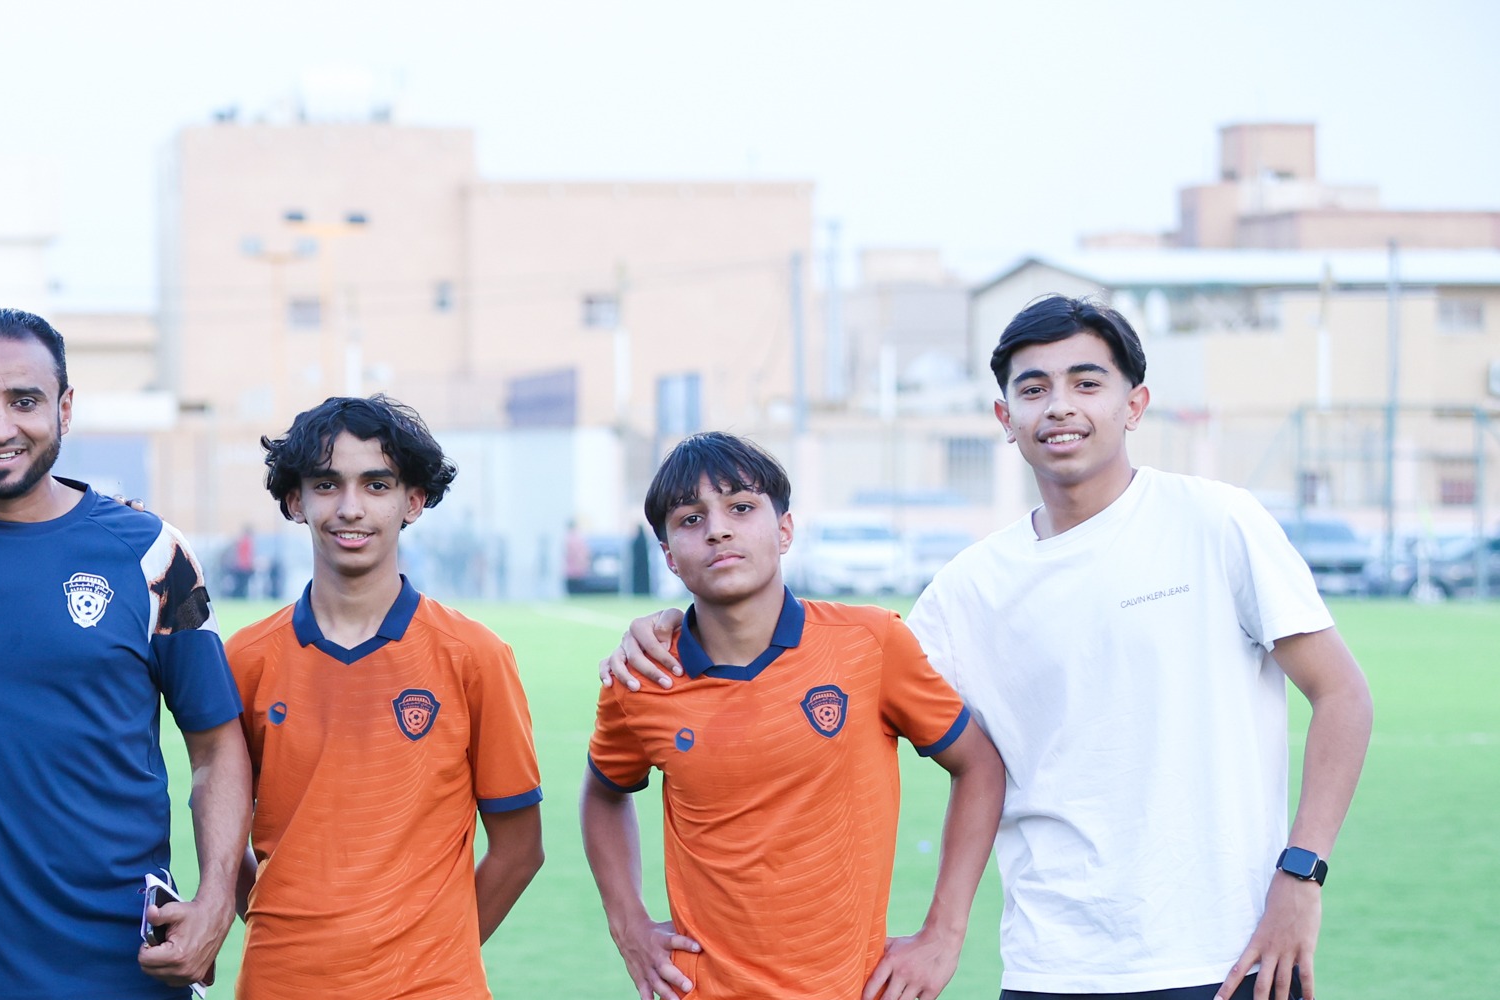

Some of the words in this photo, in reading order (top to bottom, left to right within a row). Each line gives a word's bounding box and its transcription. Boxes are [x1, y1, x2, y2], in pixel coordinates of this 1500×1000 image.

[1120, 595, 1145, 608] CALVIN
[1146, 590, 1166, 601] KLEIN
[1167, 584, 1190, 596] JEANS
